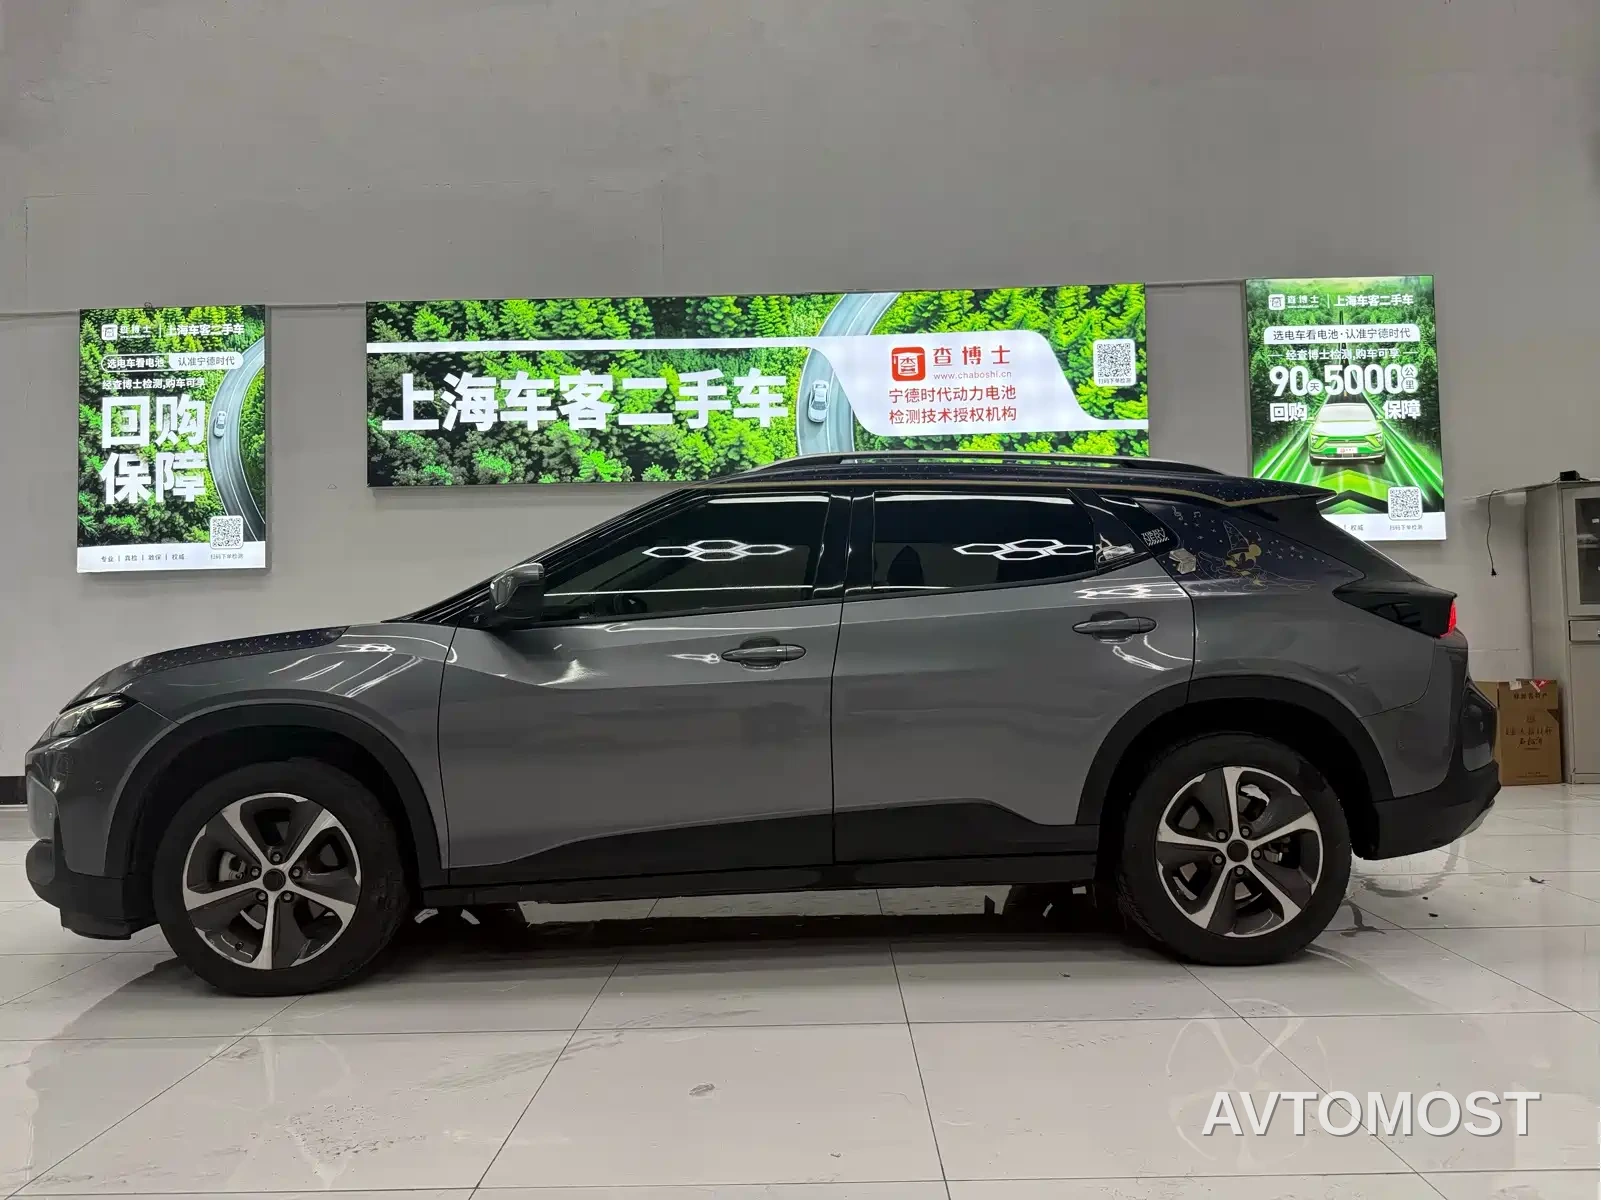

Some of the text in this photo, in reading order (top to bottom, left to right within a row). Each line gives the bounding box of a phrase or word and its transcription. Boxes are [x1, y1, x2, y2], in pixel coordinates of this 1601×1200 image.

[1333, 293, 1414, 307] 上海车客二手车
[167, 323, 245, 336] 上海车客二手车
[107, 357, 164, 370] 选电车看电池
[178, 355, 235, 367] 认准宁德时代
[932, 345, 1011, 367] 查博士
[933, 369, 1012, 380] www.chaboshi.cn
[1324, 363, 1402, 396] 5000
[381, 367, 789, 433] 上海车客二手车
[889, 384, 1017, 404] 宁德时代动力电池
[102, 393, 206, 449] 回购
[889, 405, 1017, 425] 检测技术授权机构
[1270, 400, 1421, 422] 回购 保障
[100, 450, 206, 505] 保障
